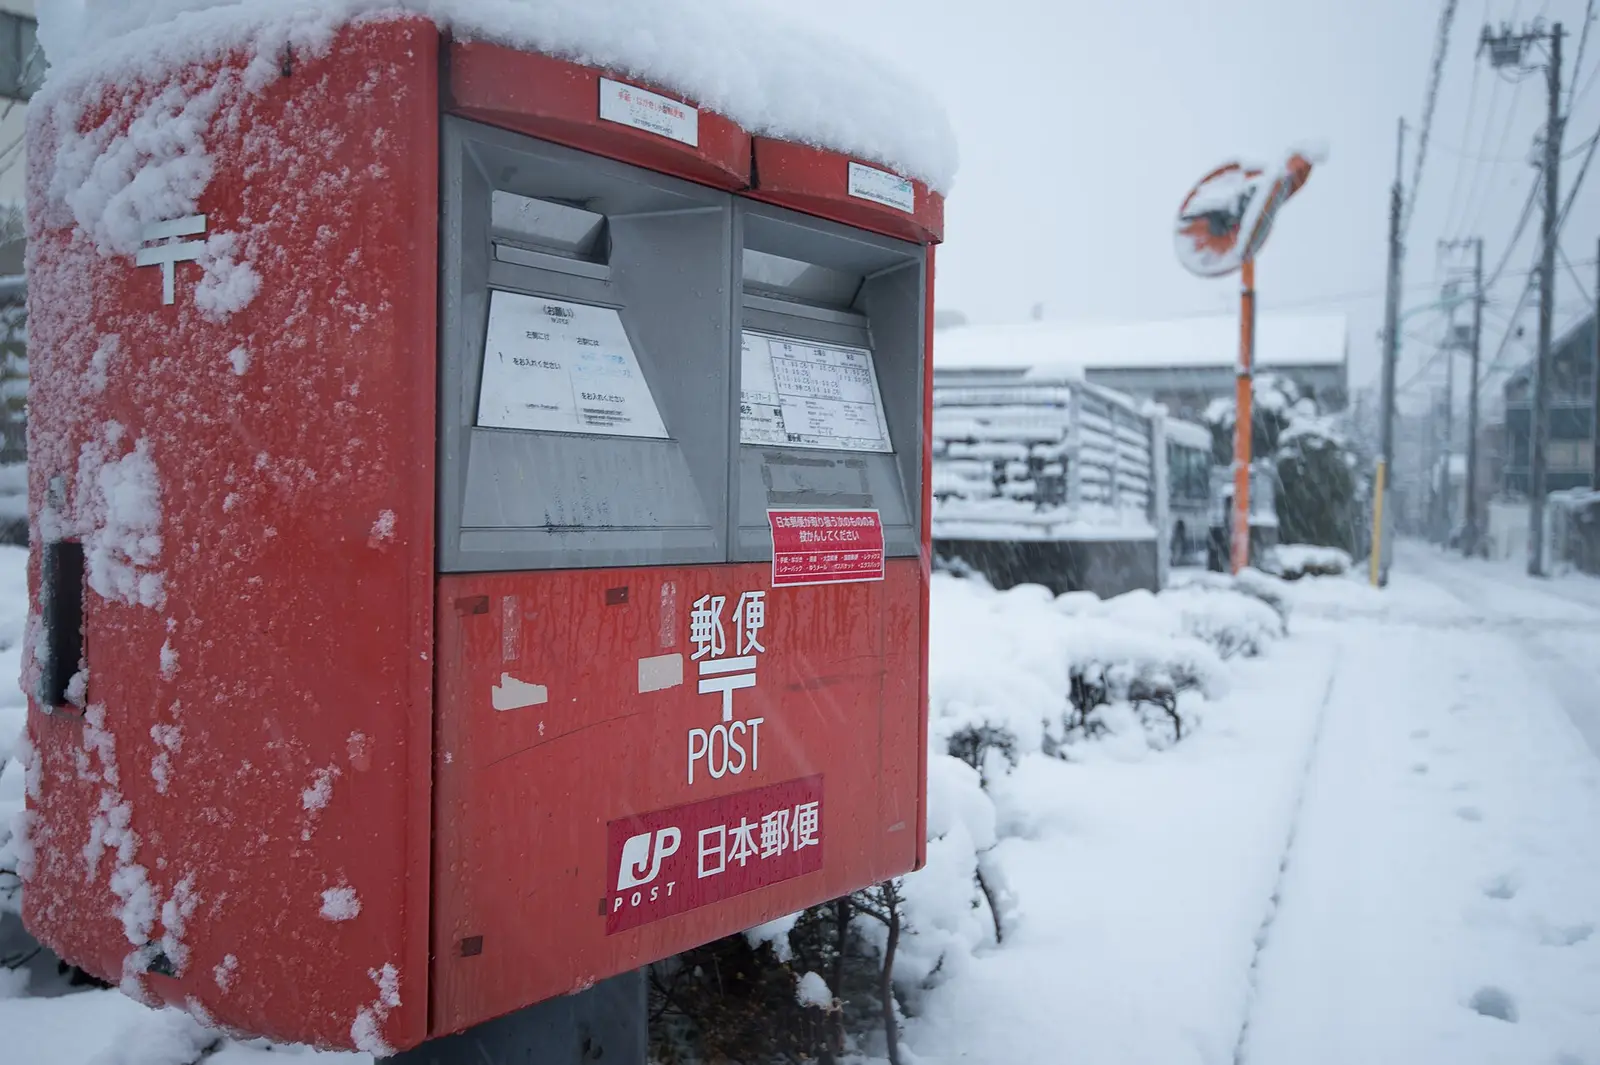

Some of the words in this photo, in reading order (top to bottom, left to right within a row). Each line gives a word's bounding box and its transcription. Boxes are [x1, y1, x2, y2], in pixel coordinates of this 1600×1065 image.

[776, 516, 875, 529] 日本郵便が取り扱う次のもののみ
[799, 530, 860, 543] 投かんしてください
[689, 590, 766, 660] 郵便
[688, 717, 765, 785] POST
[617, 826, 682, 891] JP
[698, 801, 819, 879] 日本郵便
[613, 881, 676, 913] POST
